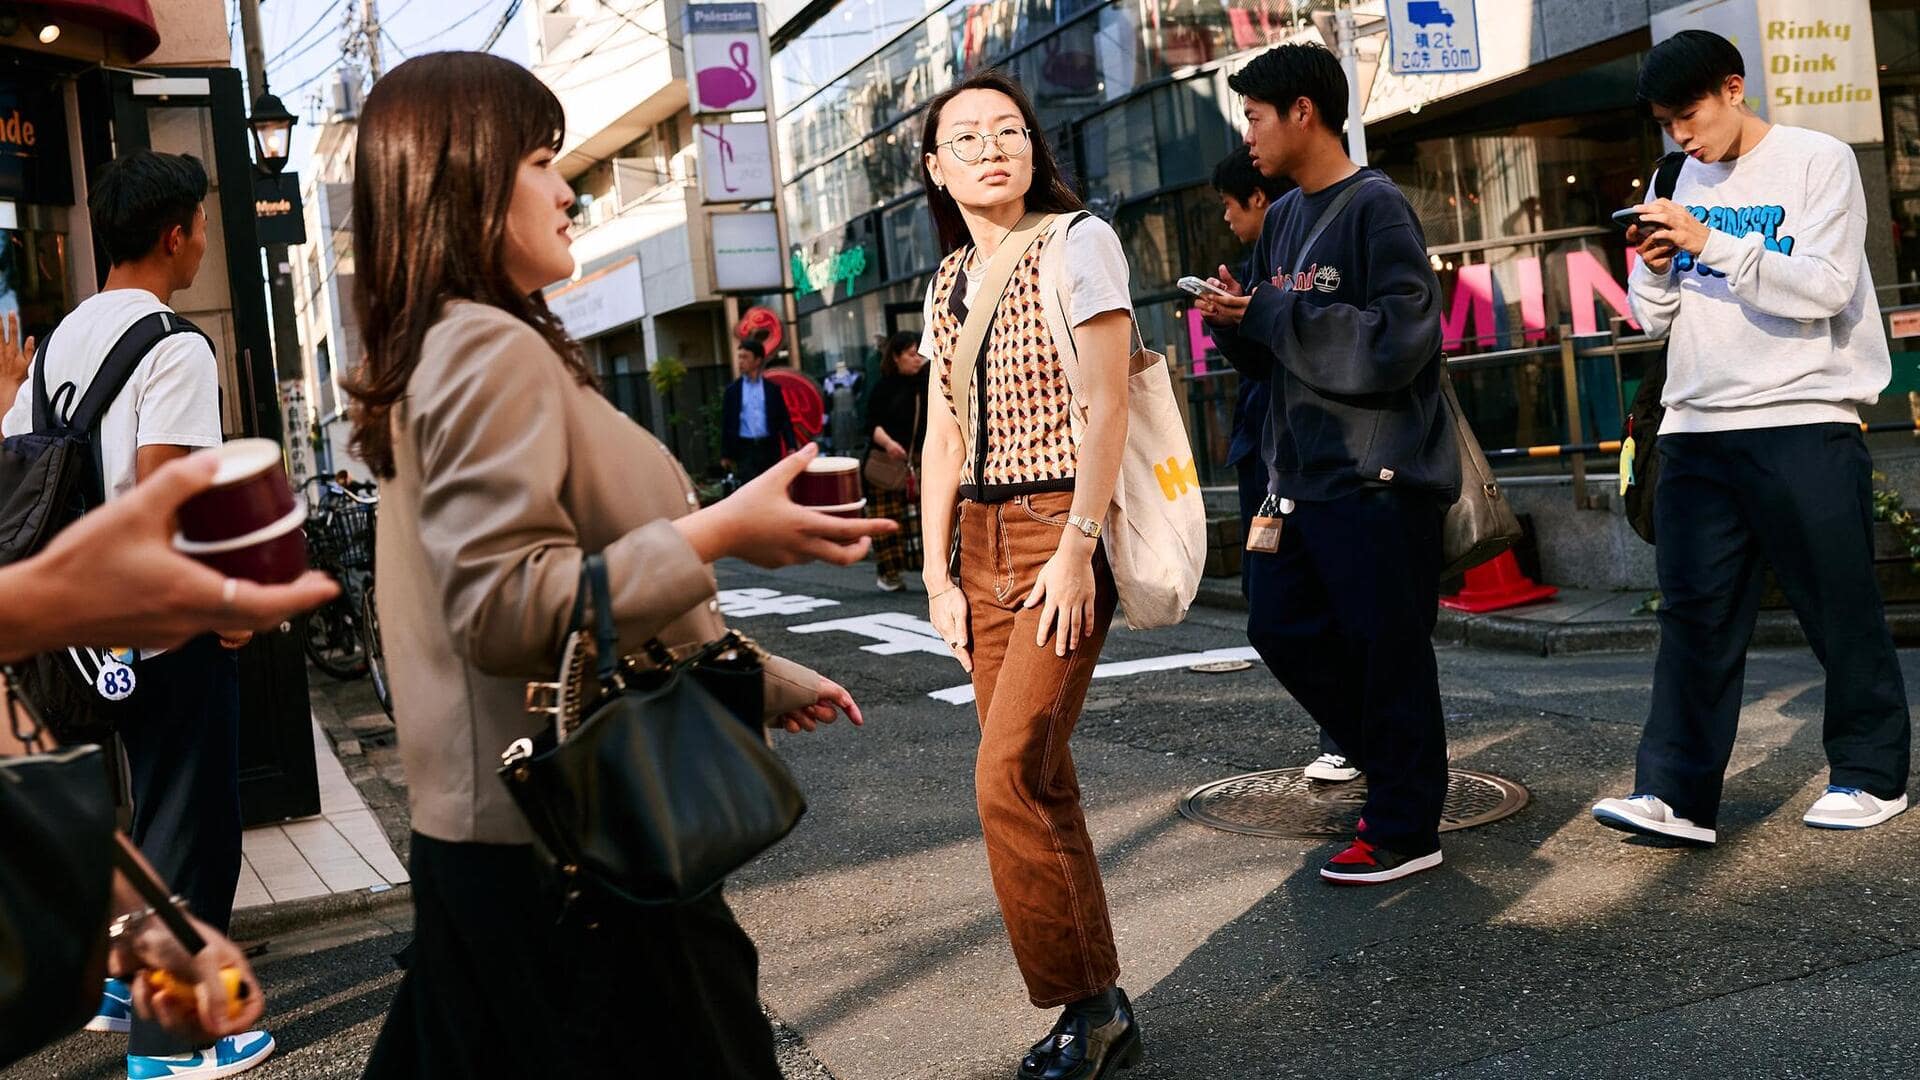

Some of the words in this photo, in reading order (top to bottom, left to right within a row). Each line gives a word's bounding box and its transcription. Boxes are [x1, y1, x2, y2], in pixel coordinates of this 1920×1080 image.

[1767, 20, 1852, 41] Rinky
[1401, 51, 1431, 69] この先
[1441, 49, 1472, 68] 60m
[1771, 53, 1838, 75] Dink
[1775, 83, 1873, 106] Studio
[104, 668, 132, 695] 83
